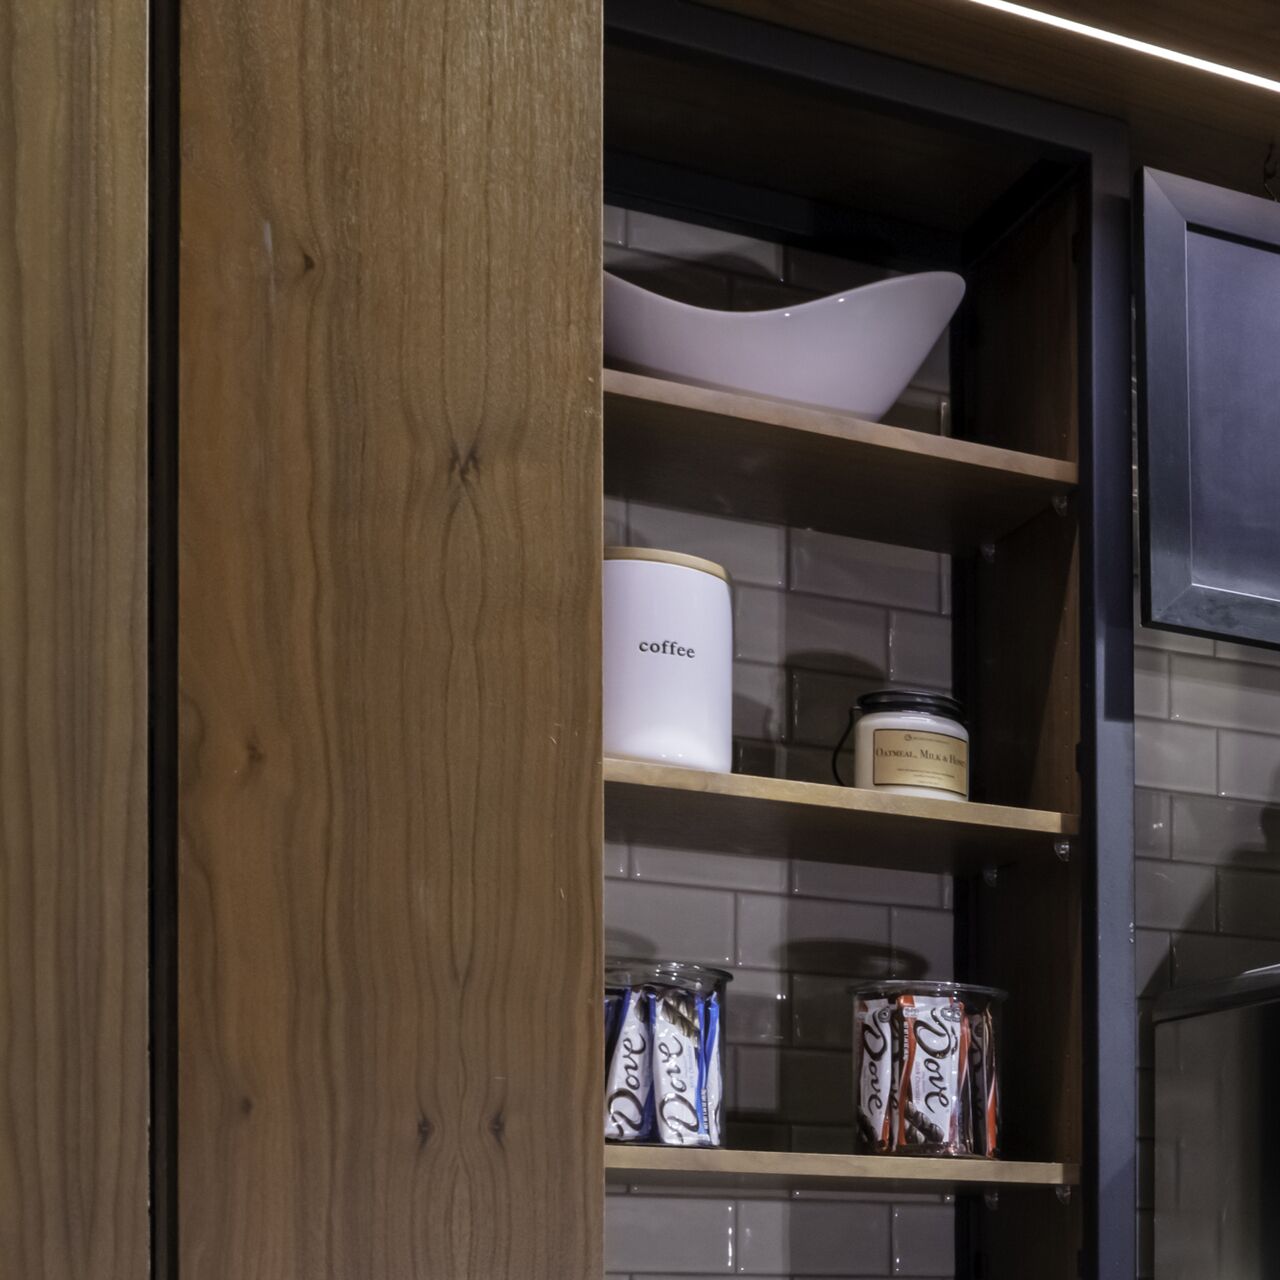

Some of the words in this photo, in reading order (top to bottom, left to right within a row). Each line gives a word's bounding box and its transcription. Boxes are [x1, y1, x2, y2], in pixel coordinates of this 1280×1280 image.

[638, 640, 696, 659] coffee
[607, 1032, 648, 1138] Dove
[658, 1035, 700, 1144] Dove
[913, 1007, 951, 1114] Dove
